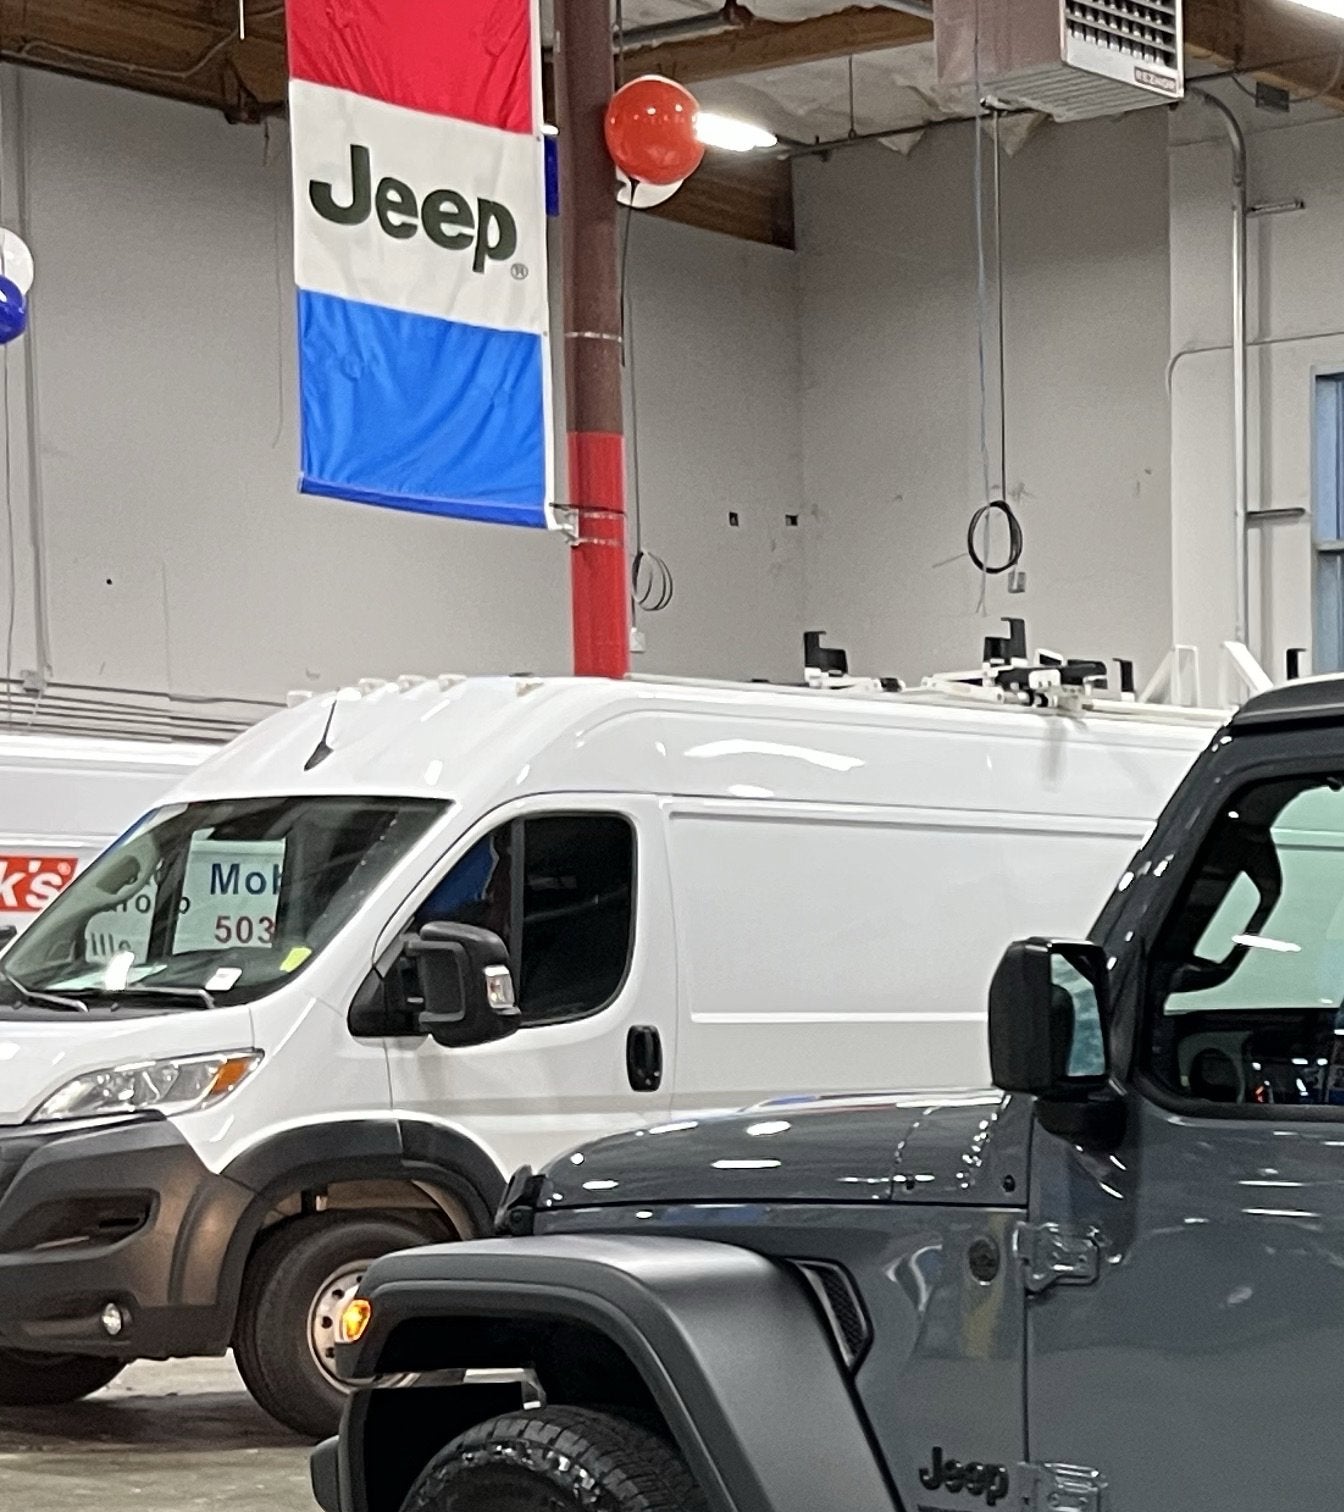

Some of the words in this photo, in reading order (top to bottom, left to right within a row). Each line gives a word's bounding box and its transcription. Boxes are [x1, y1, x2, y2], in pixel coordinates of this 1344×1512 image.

[308, 143, 518, 274] Jeep
[214, 914, 275, 944] 503
[918, 1445, 1010, 1507] Jeep
